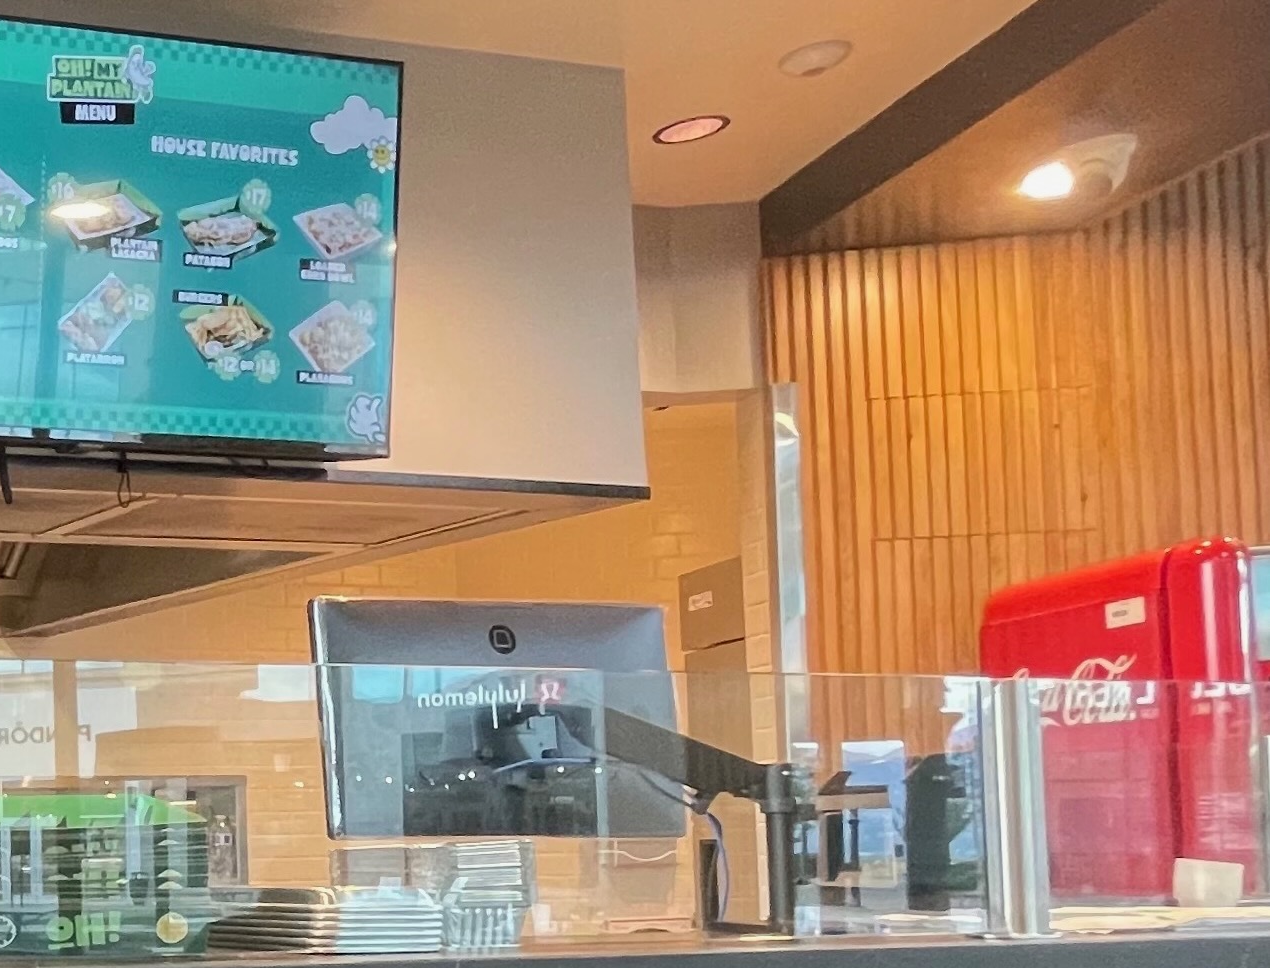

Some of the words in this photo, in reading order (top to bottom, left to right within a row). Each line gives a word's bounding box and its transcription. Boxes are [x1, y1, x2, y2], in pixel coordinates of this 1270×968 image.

[56, 59, 94, 78] OH!
[97, 61, 122, 79] MY
[51, 78, 131, 99] PLANTAIN
[74, 104, 117, 121] MENU
[151, 135, 207, 158] HOUSE
[209, 142, 299, 167] FAVORITES
[45, 911, 122, 951] OH!
